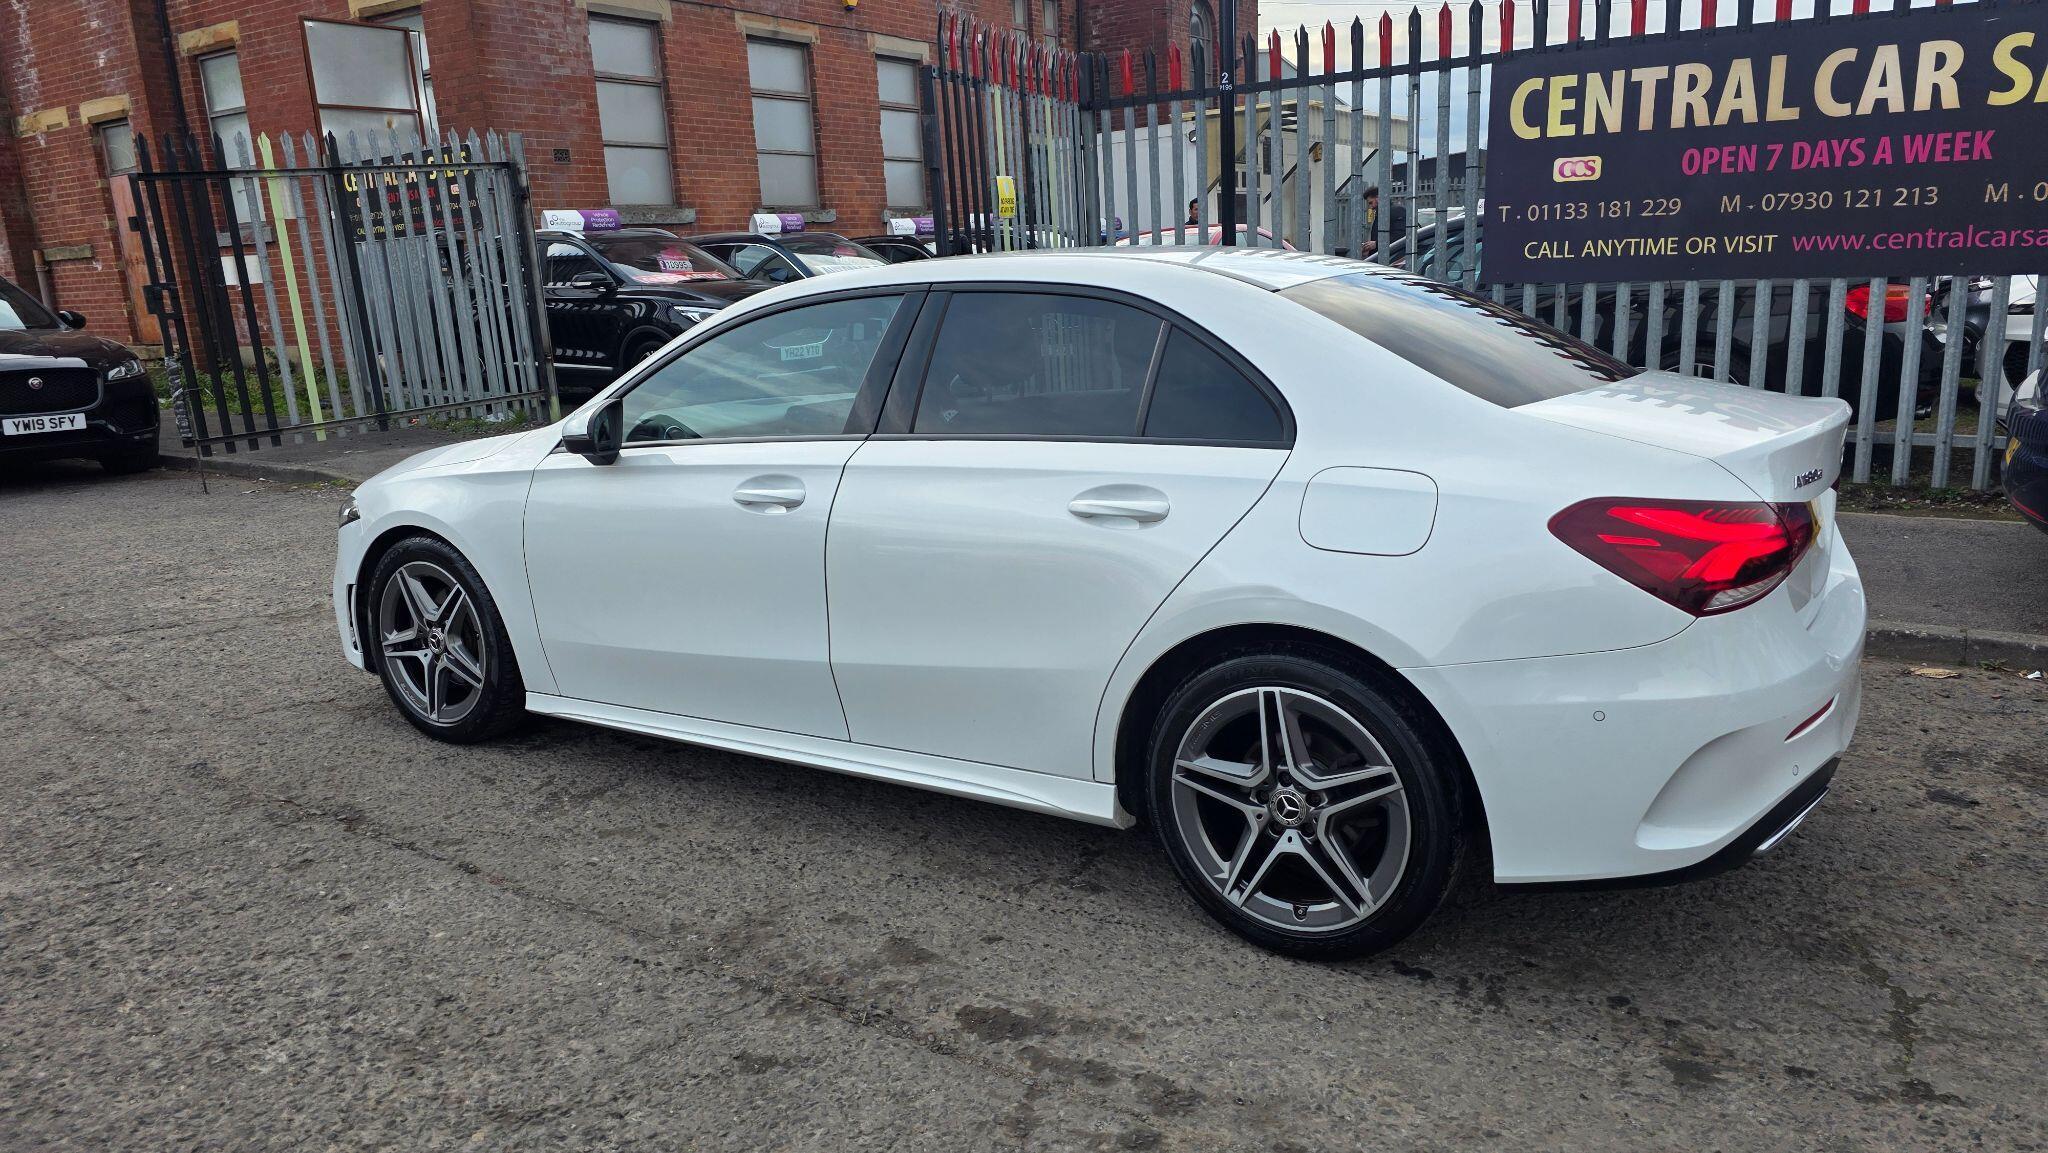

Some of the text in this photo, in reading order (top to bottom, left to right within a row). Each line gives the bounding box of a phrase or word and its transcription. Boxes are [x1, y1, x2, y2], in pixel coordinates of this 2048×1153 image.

[1221, 71, 1229, 84] 2
[1509, 54, 1800, 140] CENTRAL
[1814, 39, 1965, 118] CAR
[1682, 130, 1996, 176] OPEN 7 DAYS A WEEK
[1527, 202, 1588, 221] 01133
[1598, 200, 1632, 218] 181
[1641, 198, 1682, 217] 229
[1761, 191, 1833, 212] 07930
[1843, 188, 1882, 208] 121
[1892, 186, 1939, 206] 213
[1524, 224, 2048, 259] CALL ANYTIME OR VISIT www.centralcarsa
[12, 415, 76, 433] YW19 SFY
